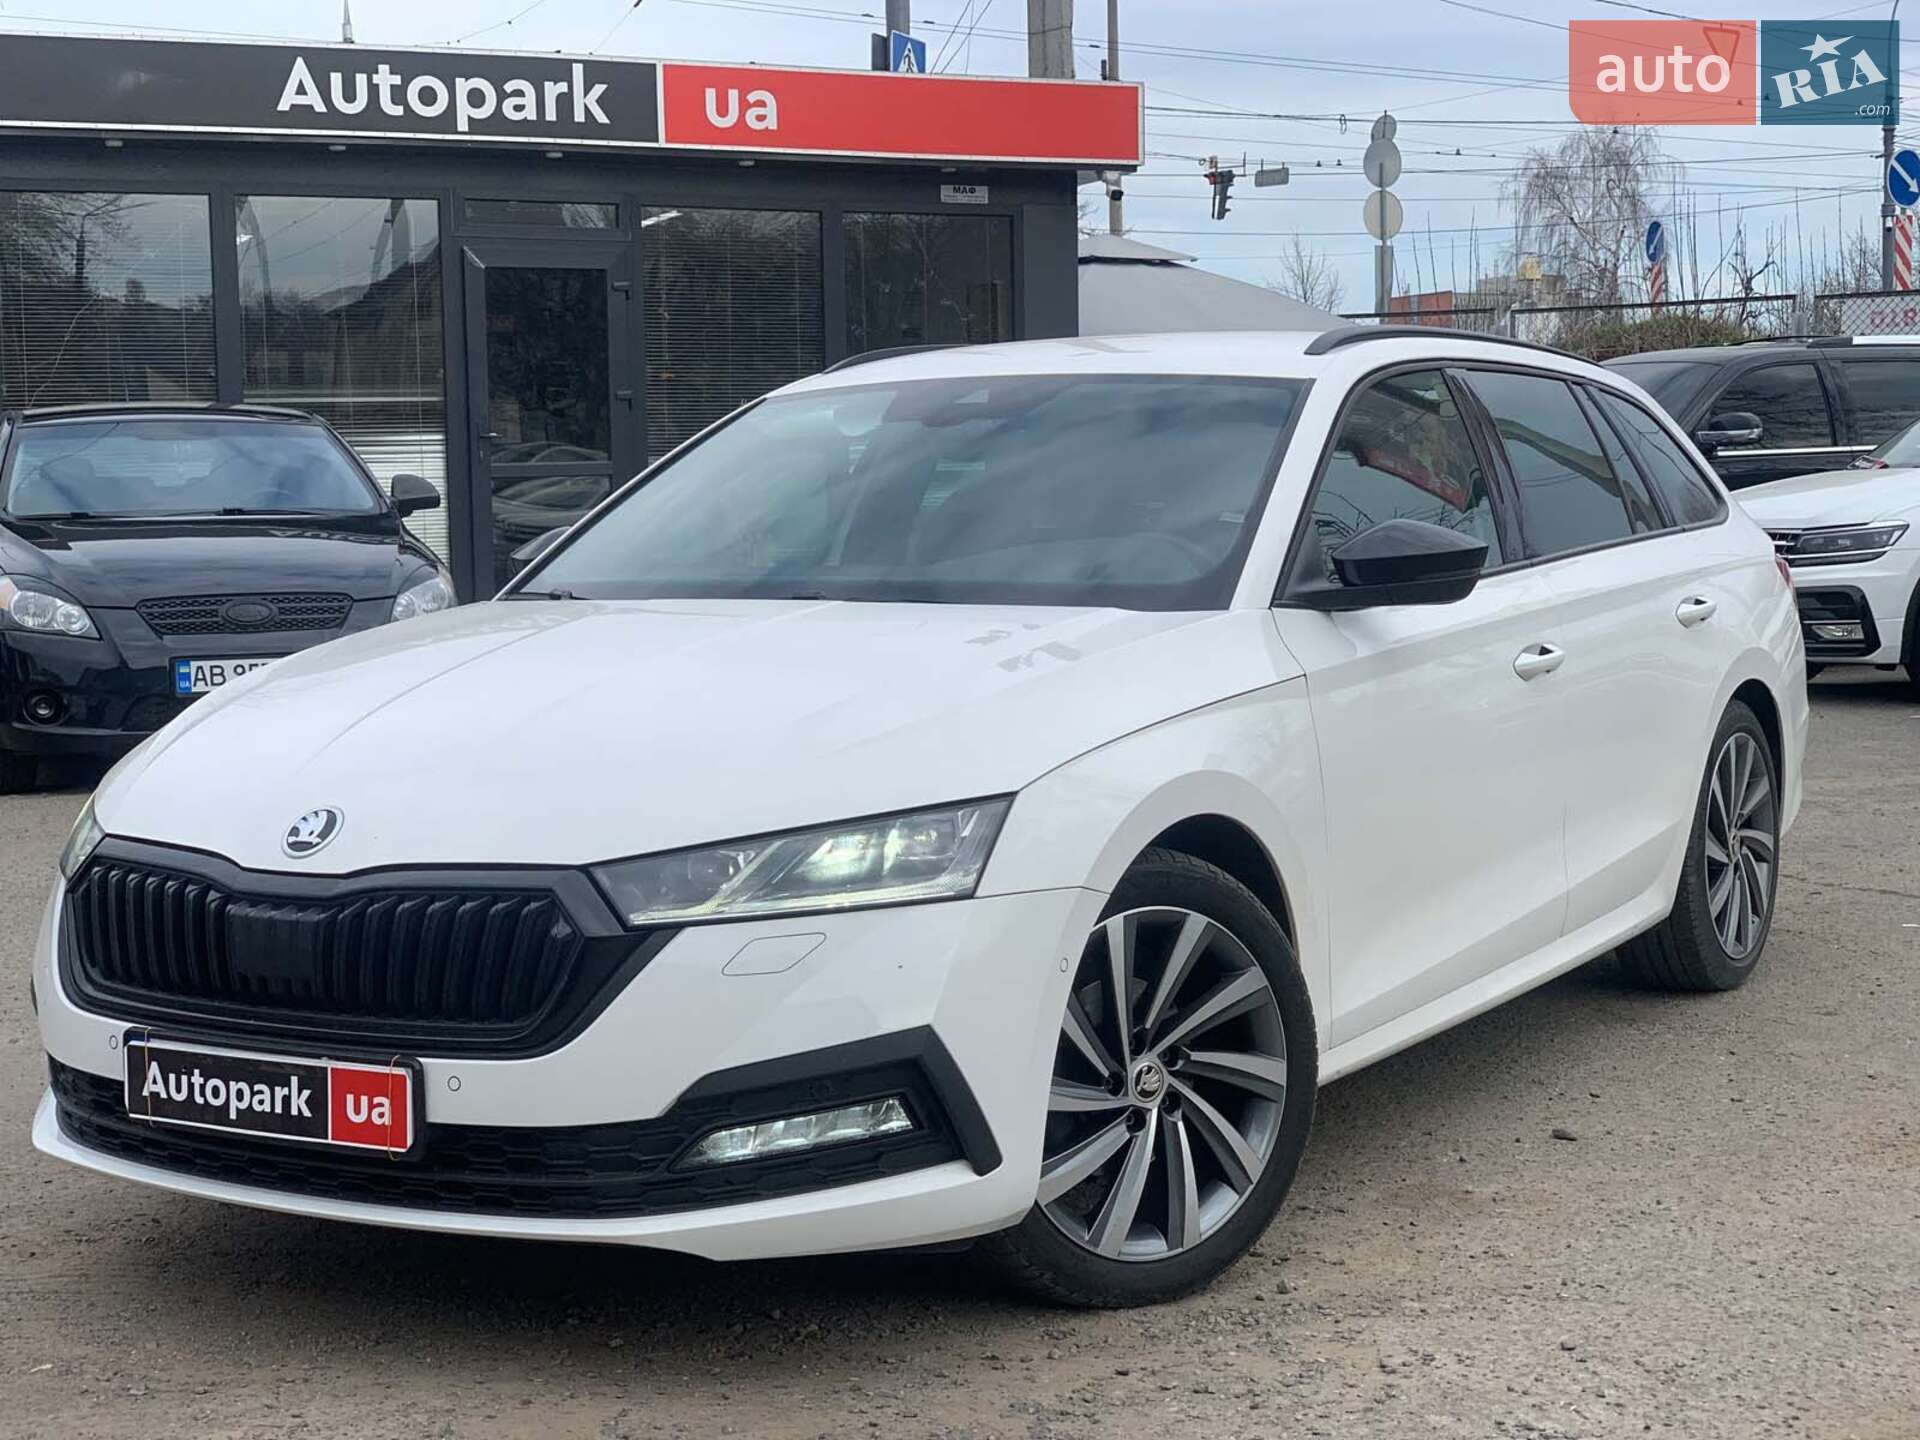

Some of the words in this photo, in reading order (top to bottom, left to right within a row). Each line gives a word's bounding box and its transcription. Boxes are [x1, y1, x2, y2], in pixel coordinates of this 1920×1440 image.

[276, 55, 610, 132] Autopark
[704, 87, 778, 130] ua
[142, 1060, 312, 1121] Autopark
[345, 1092, 392, 1126] ua
